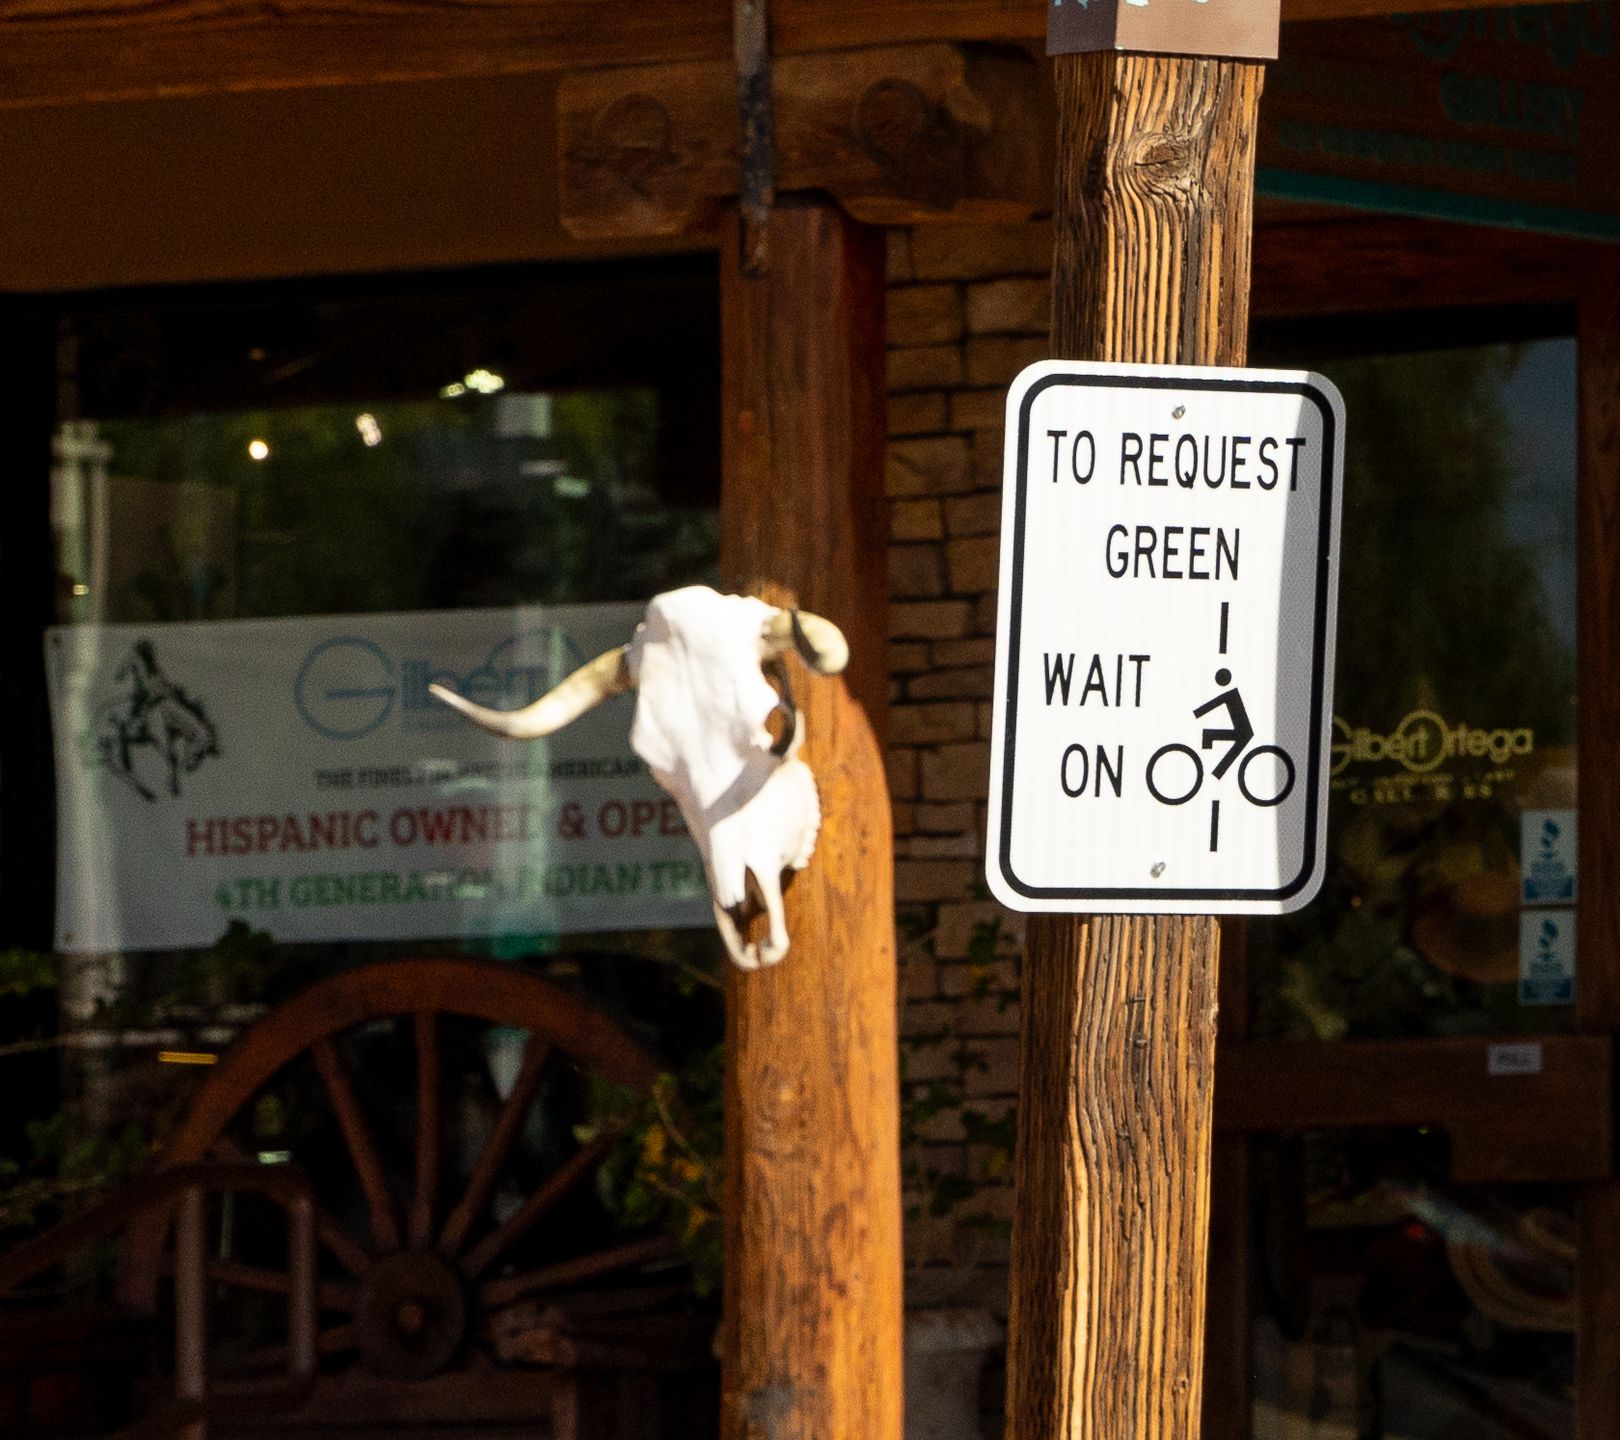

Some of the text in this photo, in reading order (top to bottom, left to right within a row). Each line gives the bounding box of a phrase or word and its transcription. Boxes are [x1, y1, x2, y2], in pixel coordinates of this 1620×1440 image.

[1047, 429, 1307, 492] TO REQUEST
[1106, 523, 1241, 580] GREEN
[1042, 653, 1151, 708] WAIT
[1398, 710, 1534, 773] Ortega
[1060, 743, 1125, 799] ON
[185, 808, 381, 859] HISPANIC
[557, 800, 586, 840] &
